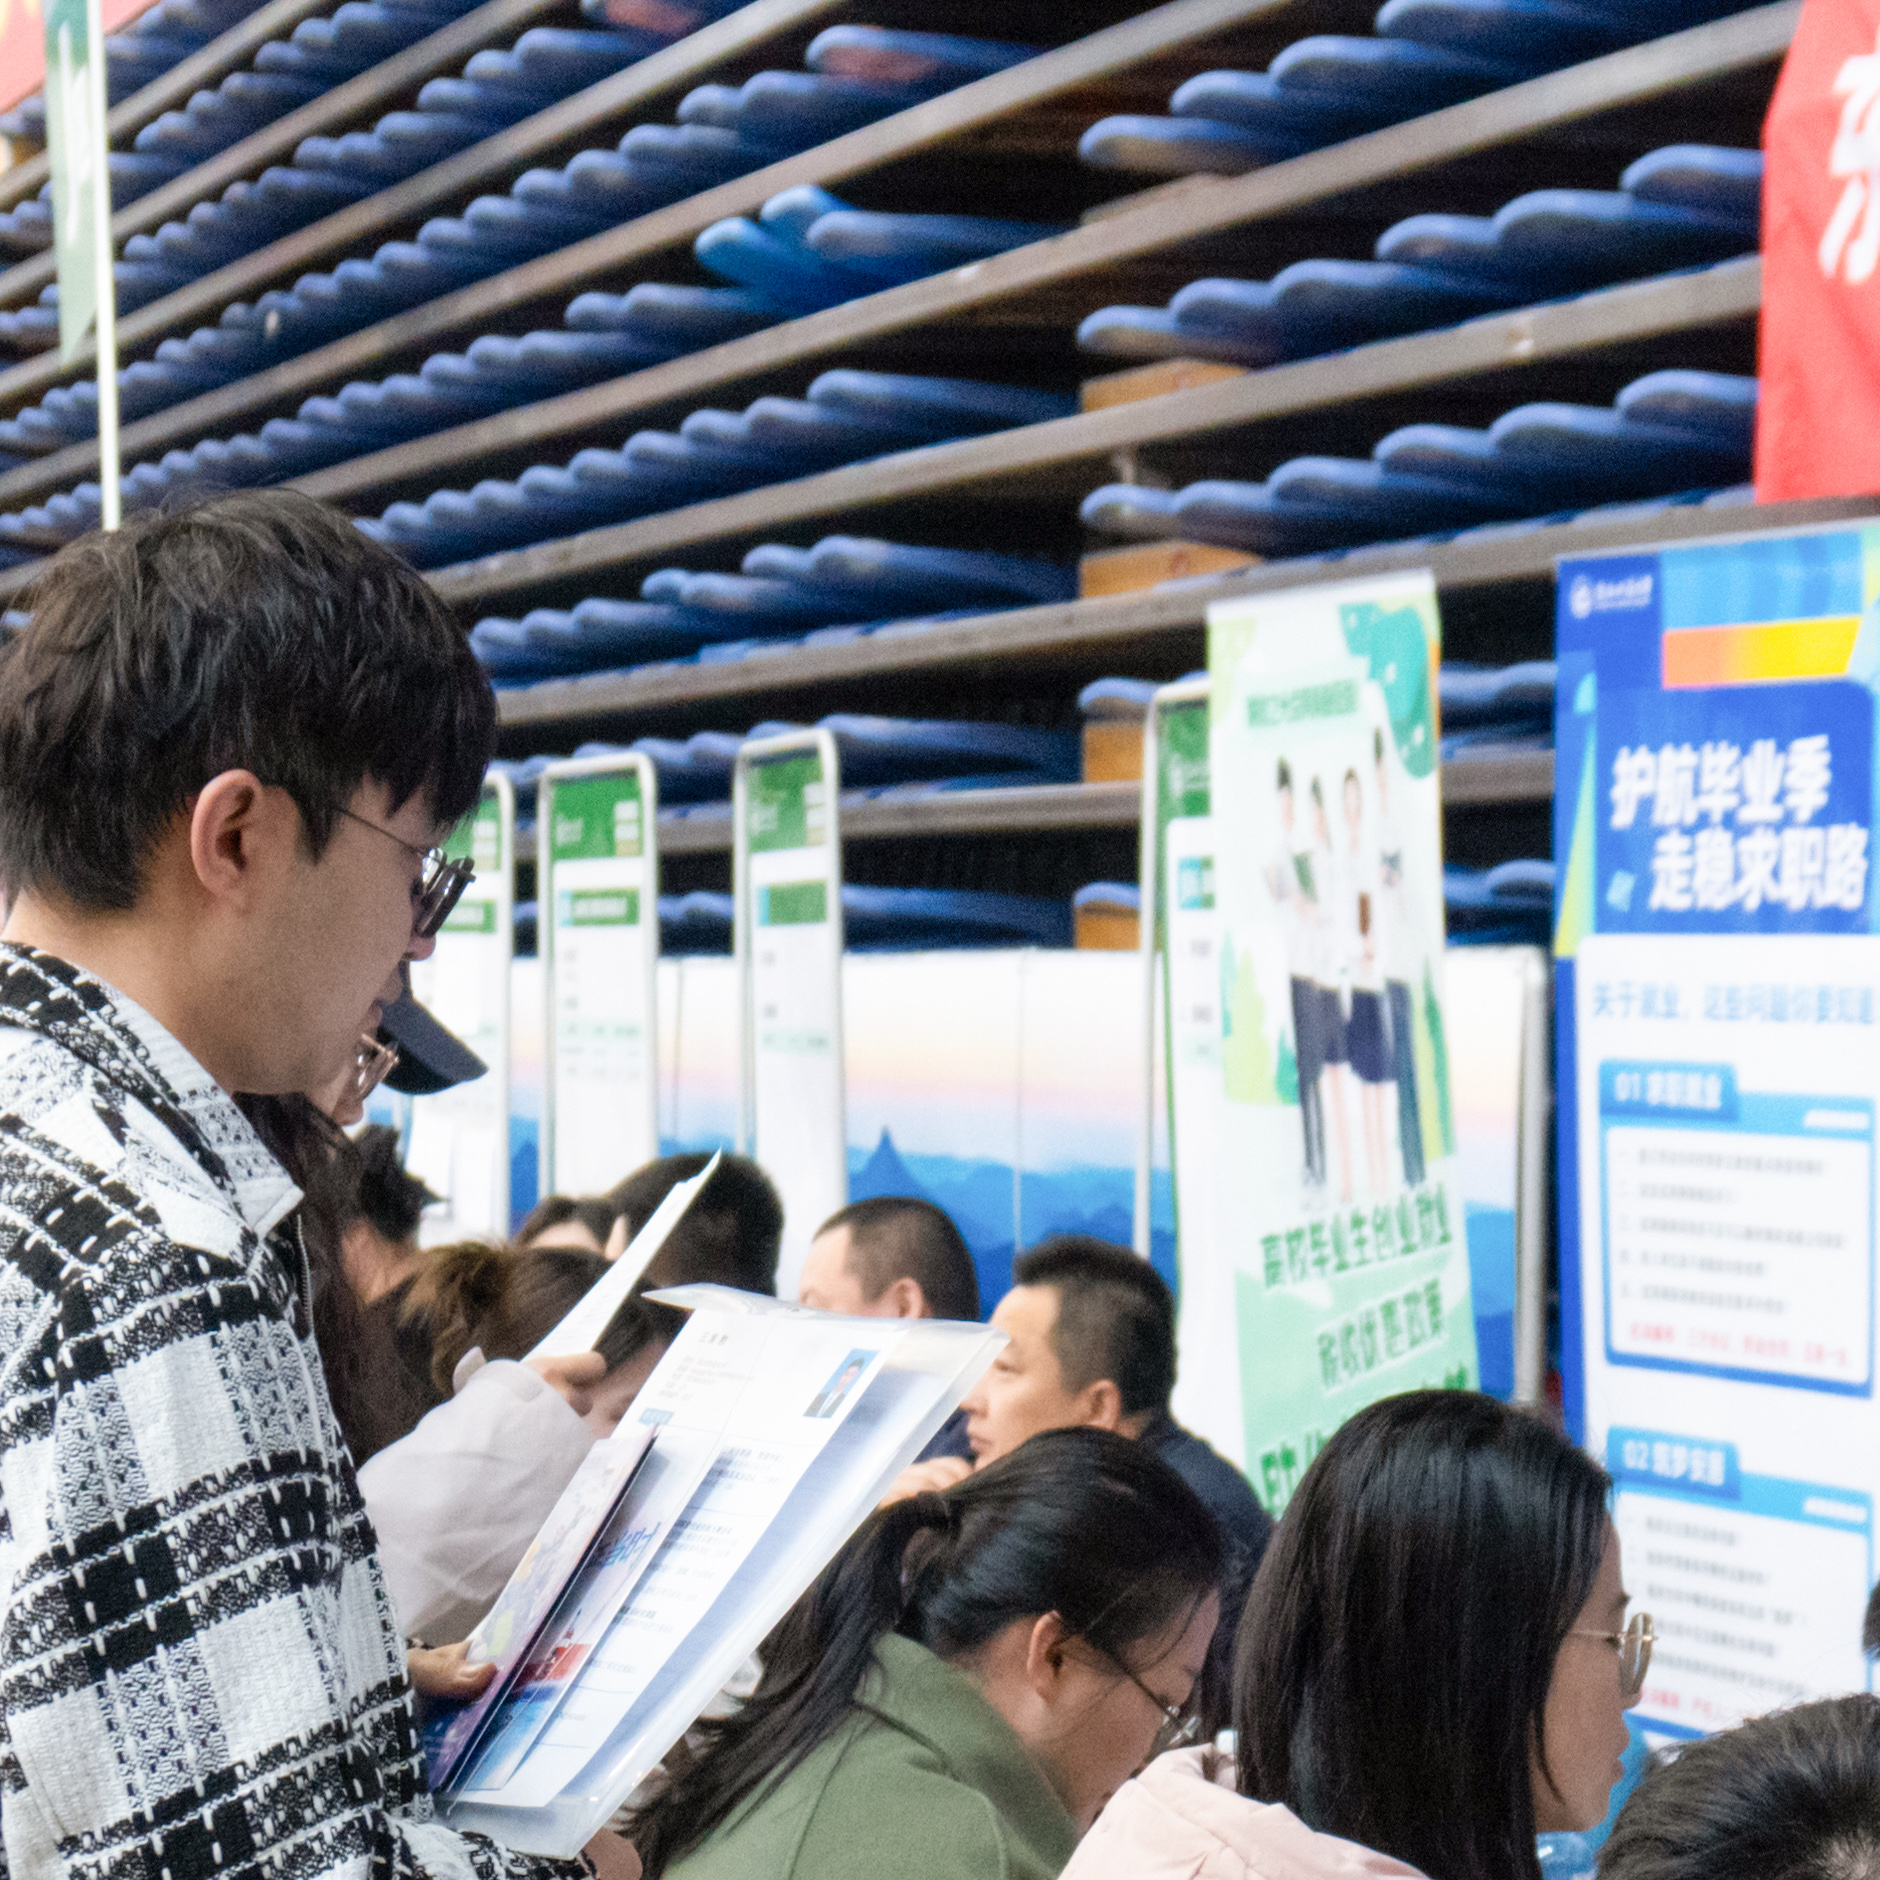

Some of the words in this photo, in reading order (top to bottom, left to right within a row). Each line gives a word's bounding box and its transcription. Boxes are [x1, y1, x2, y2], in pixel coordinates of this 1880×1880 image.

[1611, 735, 1832, 830] 护航毕业季
[1648, 823, 1869, 912] 走稳求职路
